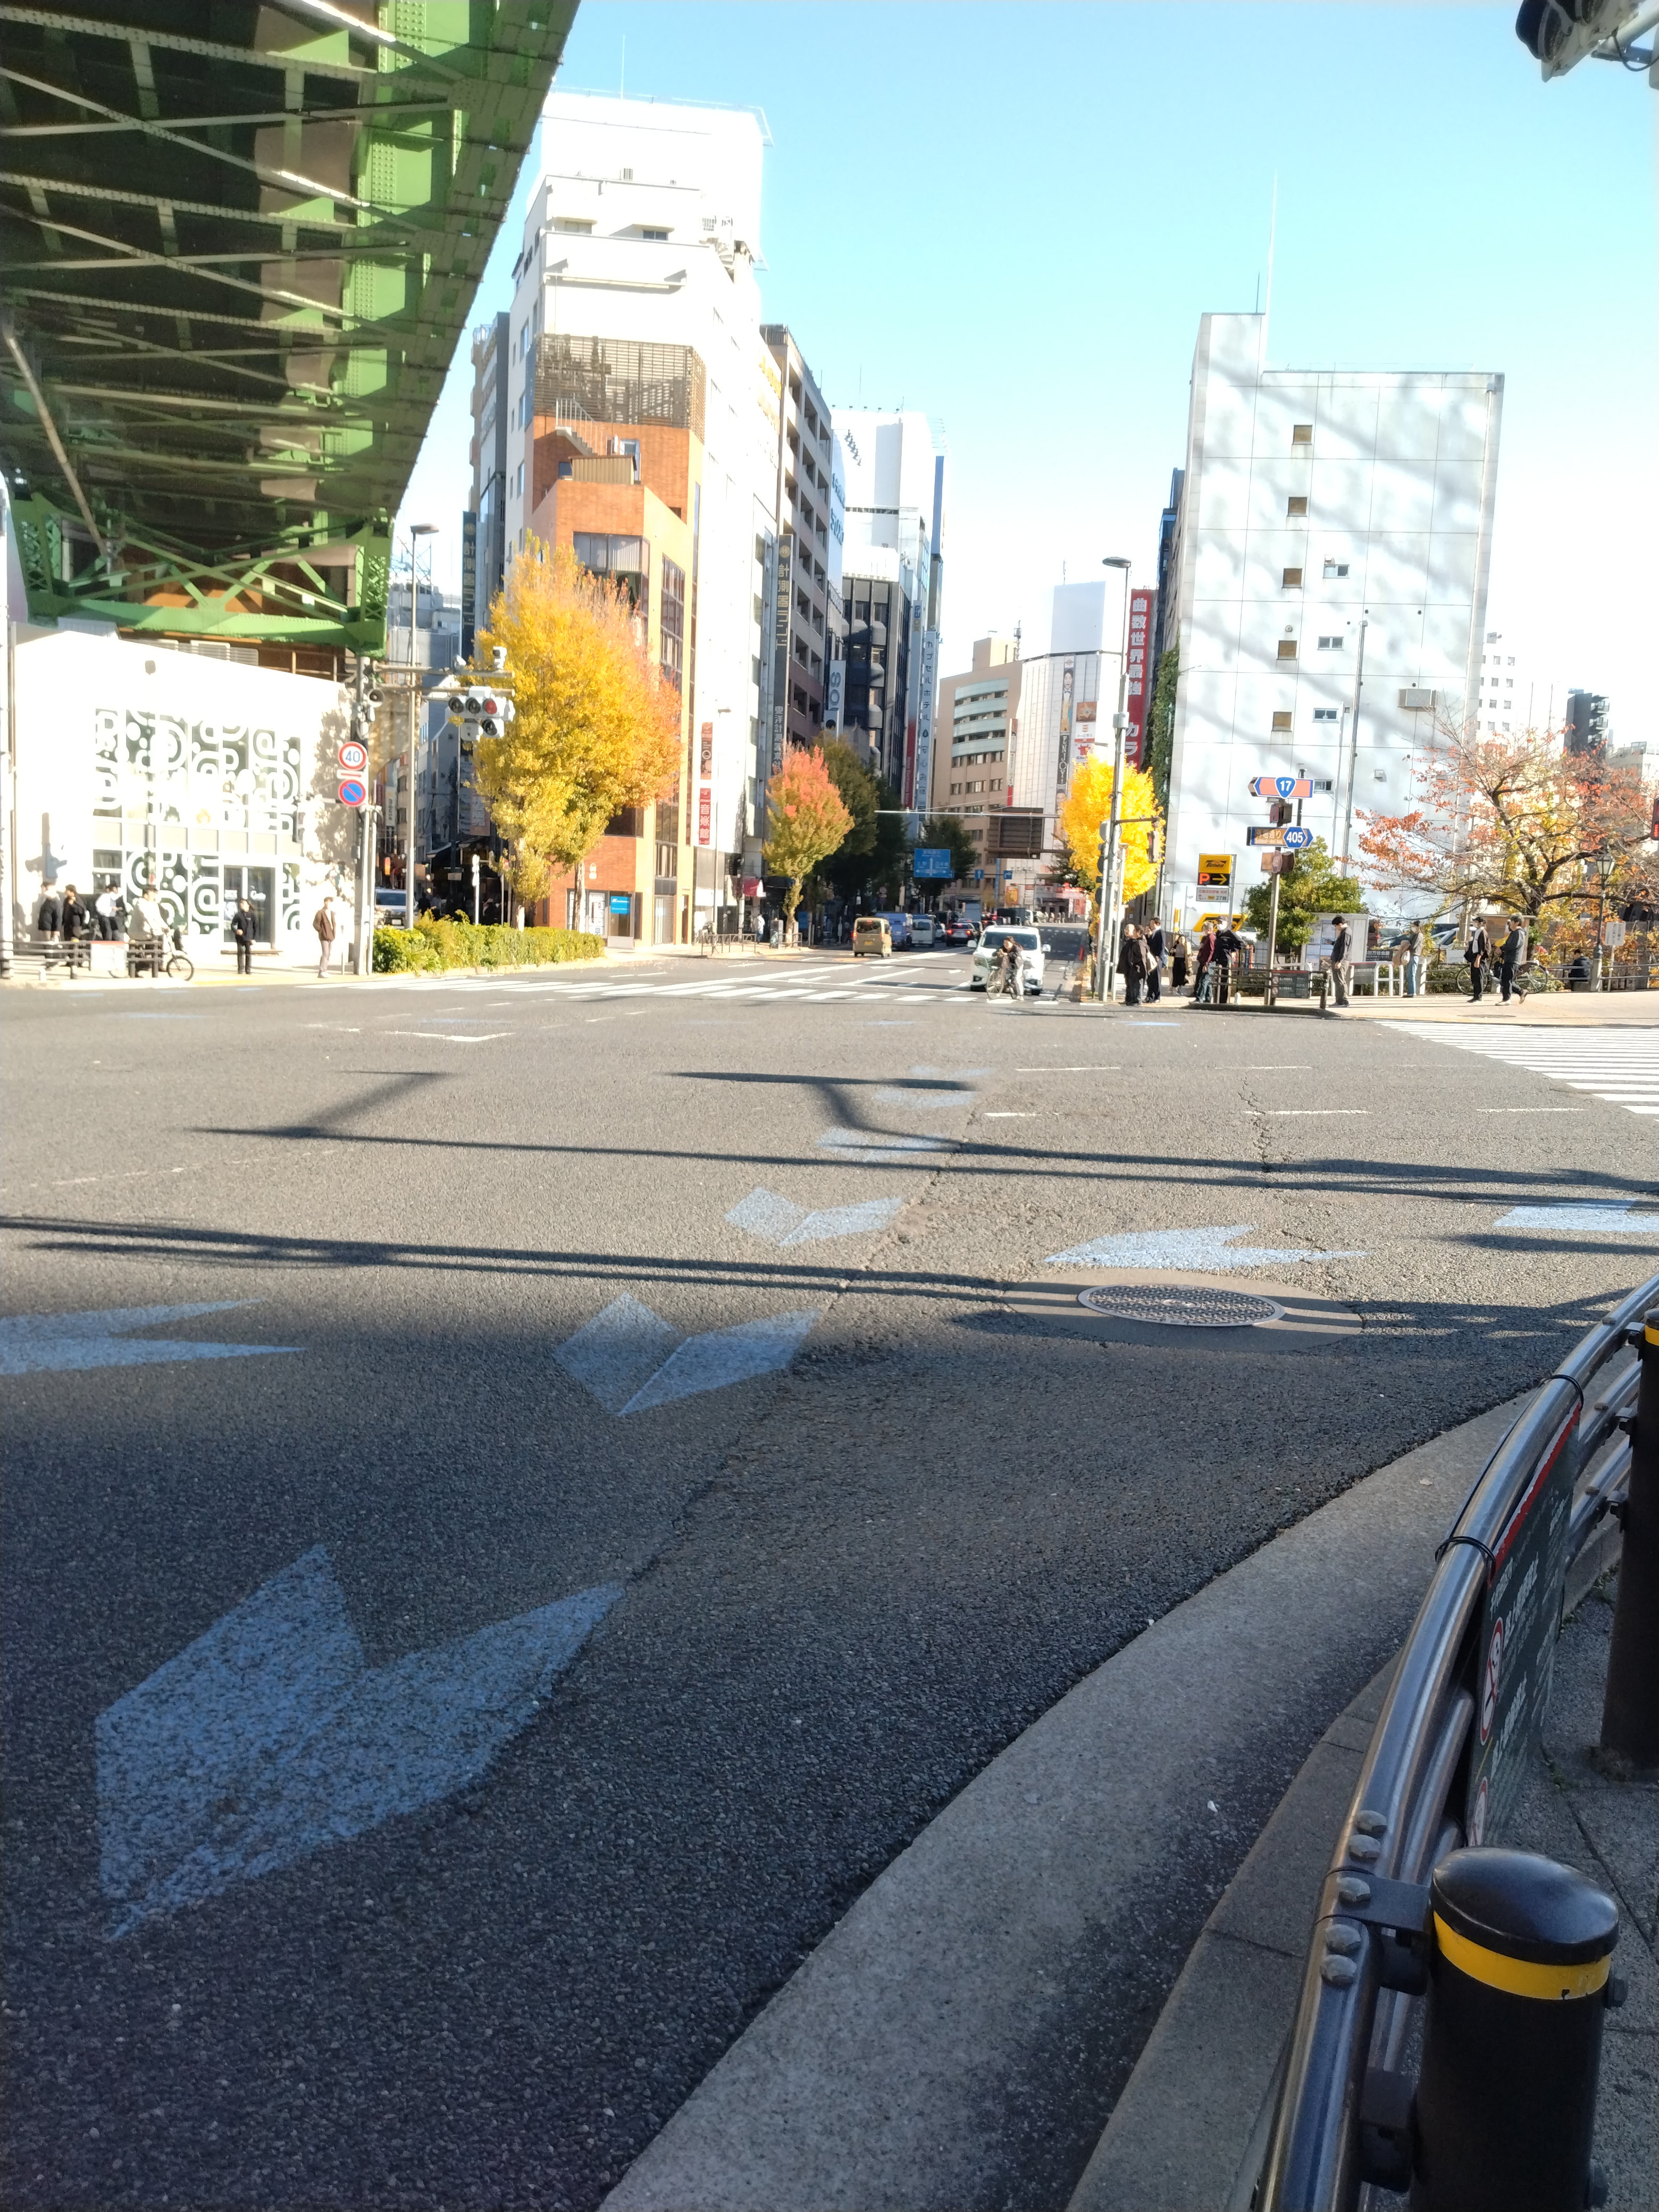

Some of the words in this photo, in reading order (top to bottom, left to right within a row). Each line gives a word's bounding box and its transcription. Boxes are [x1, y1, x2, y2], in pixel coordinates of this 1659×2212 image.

[776, 563, 790, 650] 計測器ランド
[1128, 598, 1147, 696] 曲数世界最強
[923, 641, 933, 720] カプセルホテル
[345, 750, 361, 763] 40
[1280, 781, 1292, 791] 17
[700, 803, 710, 839] 音楽館
[1287, 832, 1303, 843] 405
[1199, 873, 1210, 885] P
